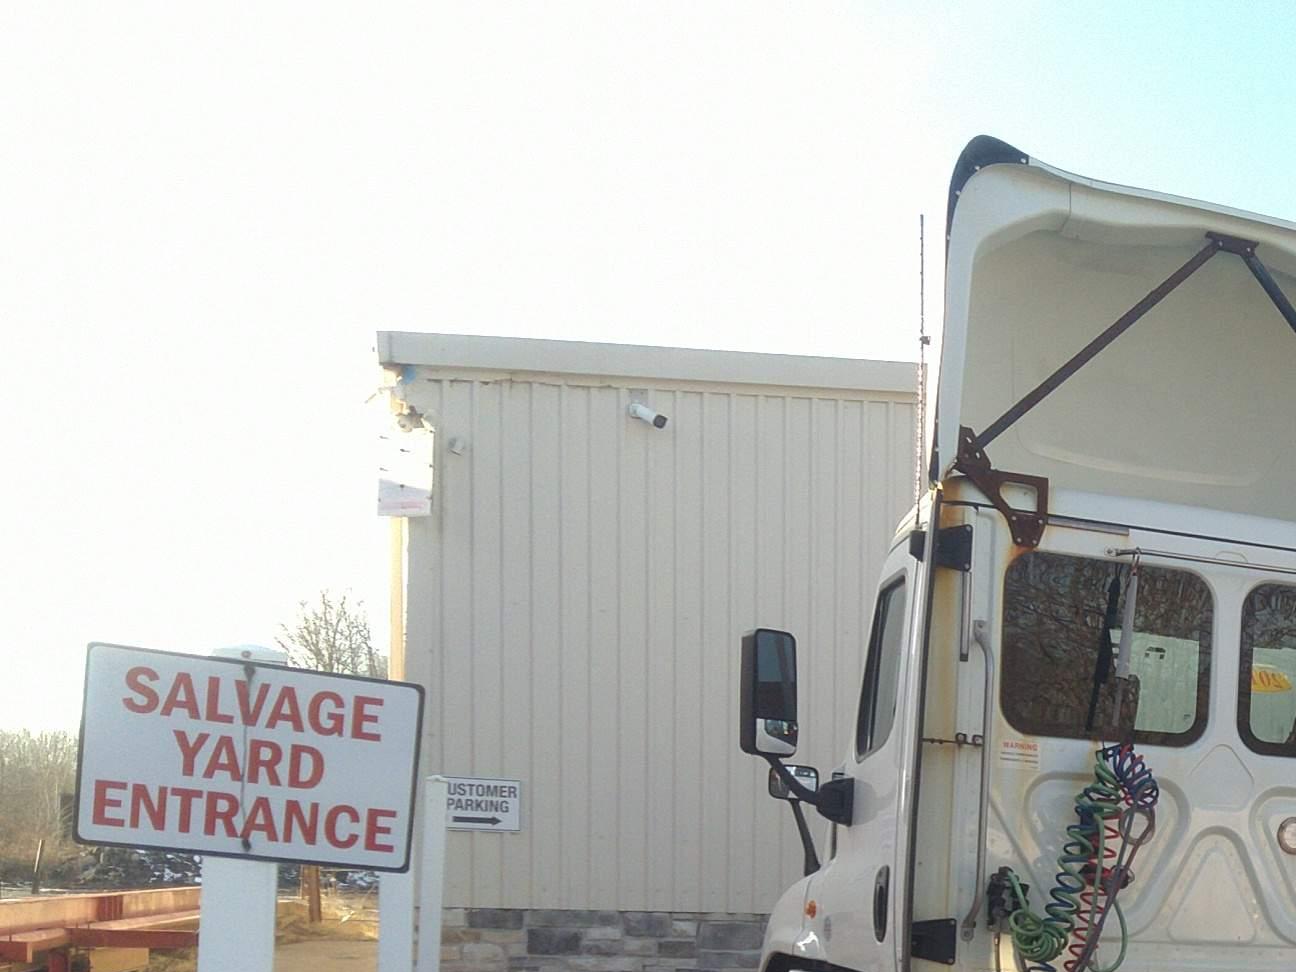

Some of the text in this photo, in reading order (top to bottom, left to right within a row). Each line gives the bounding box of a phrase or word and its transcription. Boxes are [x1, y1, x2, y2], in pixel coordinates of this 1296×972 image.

[122, 666, 385, 742] SALVAGE
[173, 729, 325, 790] YARD
[92, 779, 397, 854] ENTRANCE
[447, 782, 518, 799] USTOMER
[447, 797, 510, 813] PARKING
